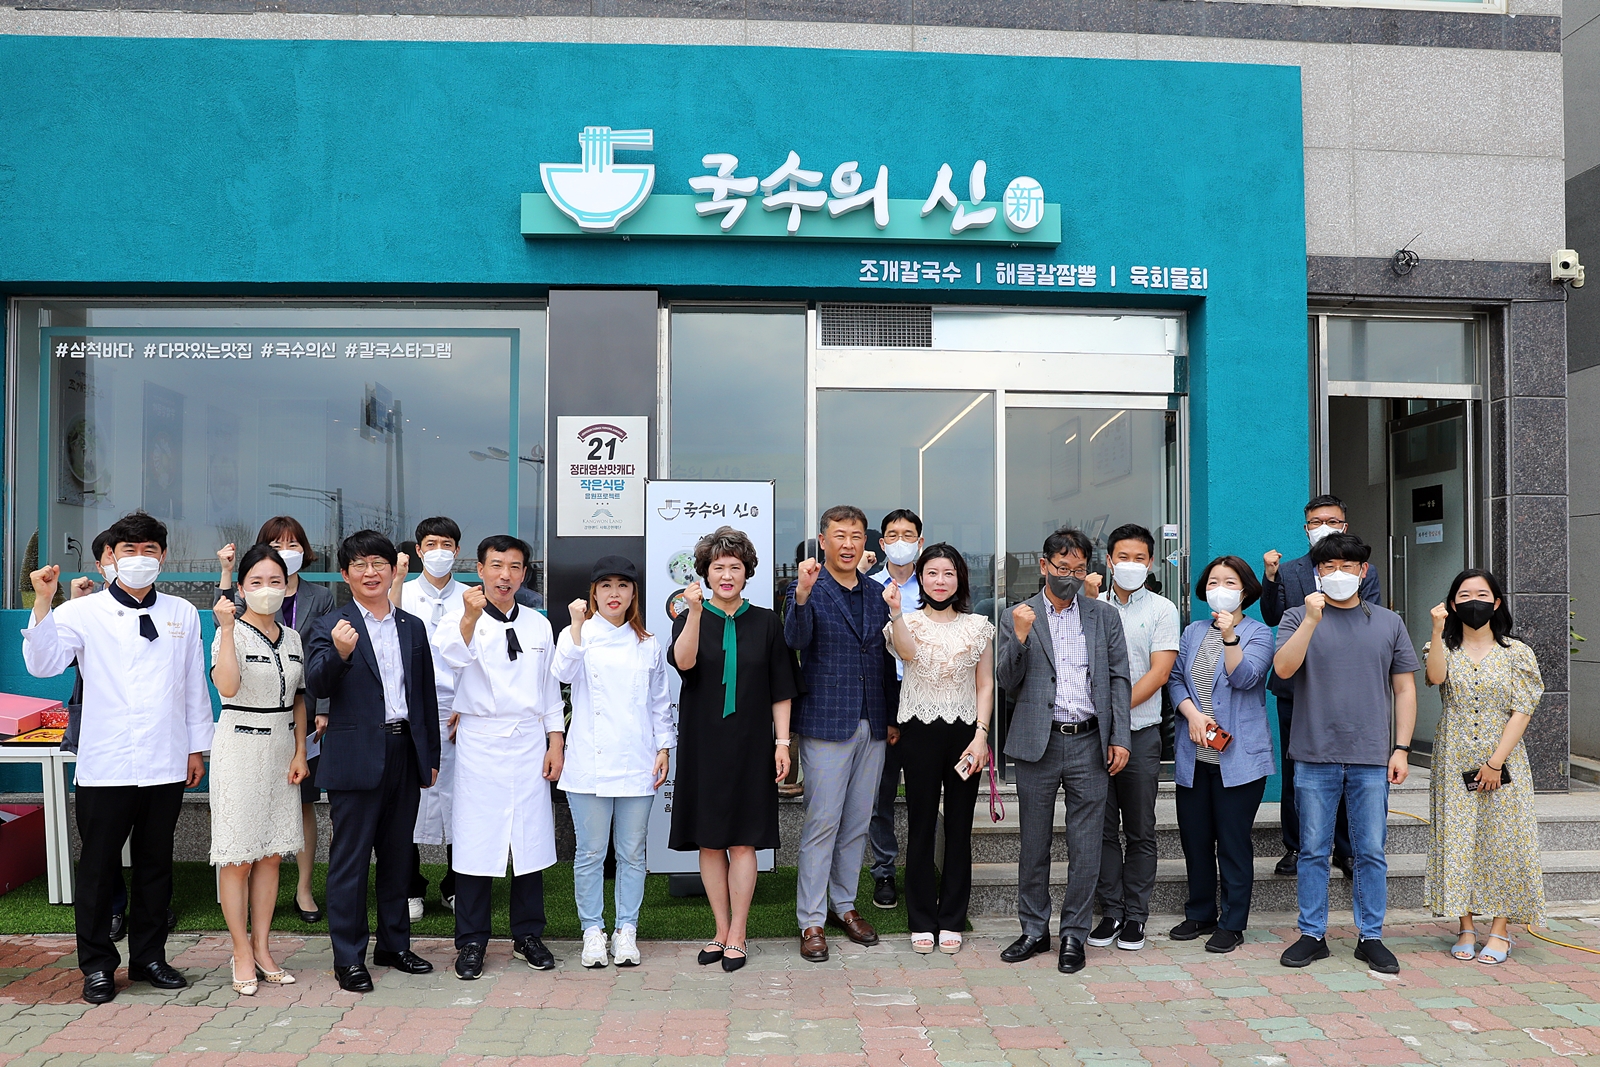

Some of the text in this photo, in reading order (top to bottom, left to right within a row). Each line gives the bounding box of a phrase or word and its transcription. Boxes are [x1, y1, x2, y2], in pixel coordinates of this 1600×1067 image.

[688, 149, 998, 236] 국수의 신
[1006, 181, 1043, 225] 新
[858, 259, 1209, 290] 조개칼국수 해물칼짬뽕 육회물회
[54, 342, 453, 361] #삼척바다 #다맛있는맛집 #국수의신 #칼국스타그램
[587, 436, 617, 461] 21
[570, 464, 635, 476] 정태영삼맛캐다
[580, 479, 625, 491] 작은식당
[683, 501, 749, 519] 국수의 신
